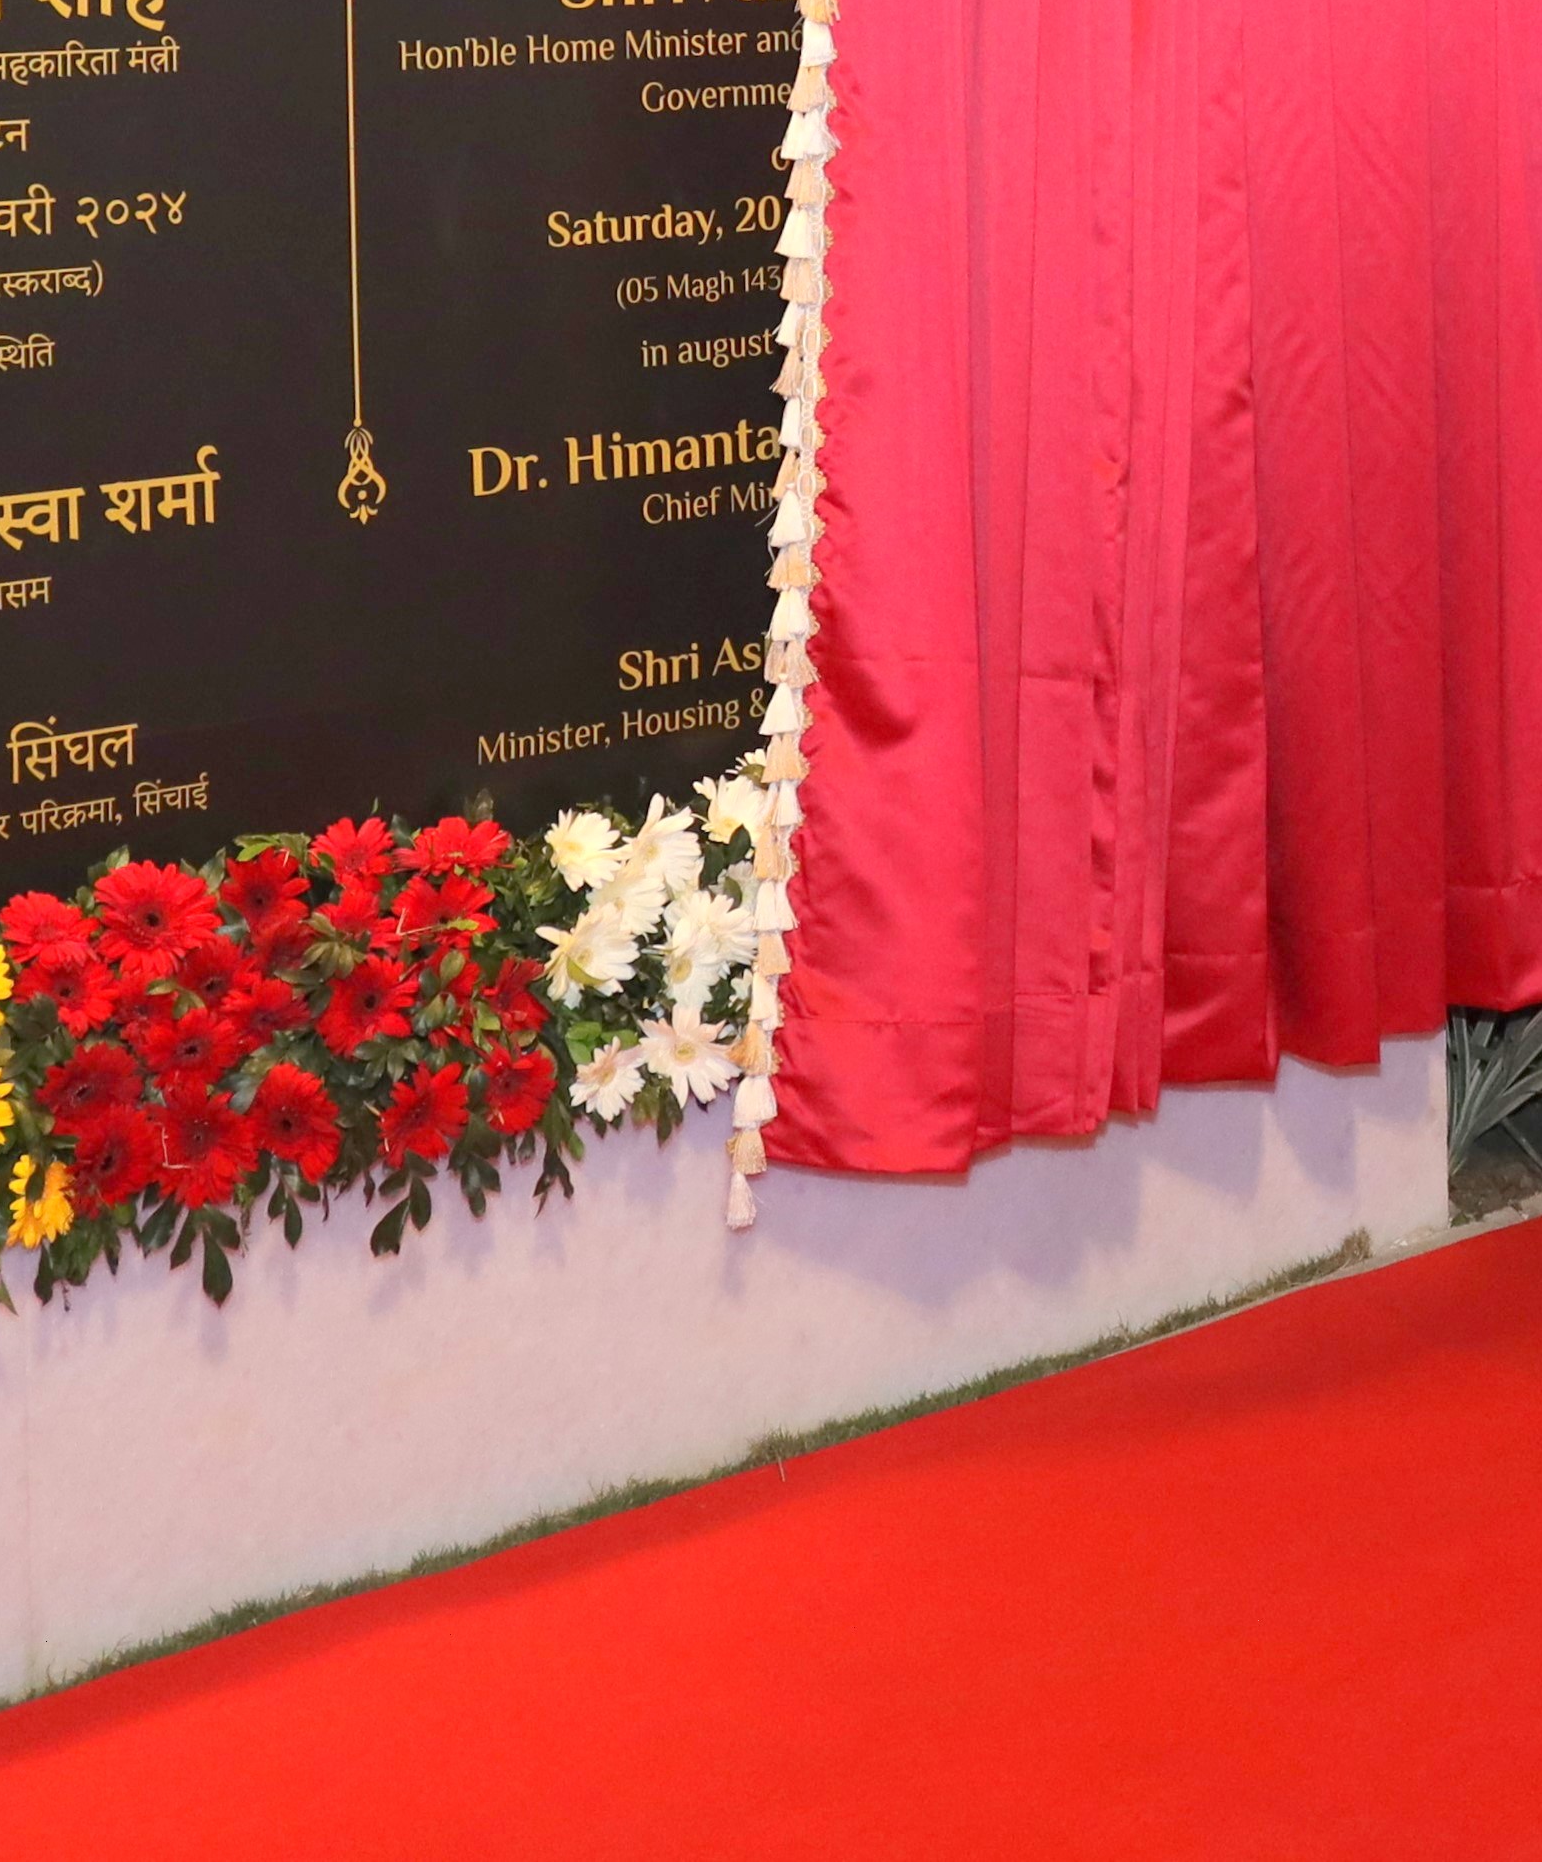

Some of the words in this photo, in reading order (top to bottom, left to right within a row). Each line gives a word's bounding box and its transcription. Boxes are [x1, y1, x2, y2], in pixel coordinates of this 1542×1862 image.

[125, 34, 181, 73] मंत्री
[399, 36, 518, 72] Hon'ble
[528, 34, 616, 65] Home
[625, 29, 748, 61] Minister
[641, 80, 793, 115] Governme
[75, 191, 187, 239] २०२४
[547, 203, 724, 248] Saturday,
[735, 194, 782, 233] 20
[616, 277, 659, 306] (05
[667, 271, 735, 303] Magh
[740, 266, 781, 295] 143
[641, 344, 668, 367] in
[677, 328, 774, 373] august
[467, 446, 548, 497] Dr.
[564, 418, 781, 487] Himanta
[98, 444, 222, 535] शर्मा
[642, 485, 722, 525] Chief
[618, 642, 700, 691] Shri
[5, 715, 139, 785] सिंघल
[478, 722, 611, 763] Minister,
[622, 699, 741, 740] Housing
[19, 796, 123, 835] परिक्रमा,
[132, 771, 210, 816] सिंचाई
